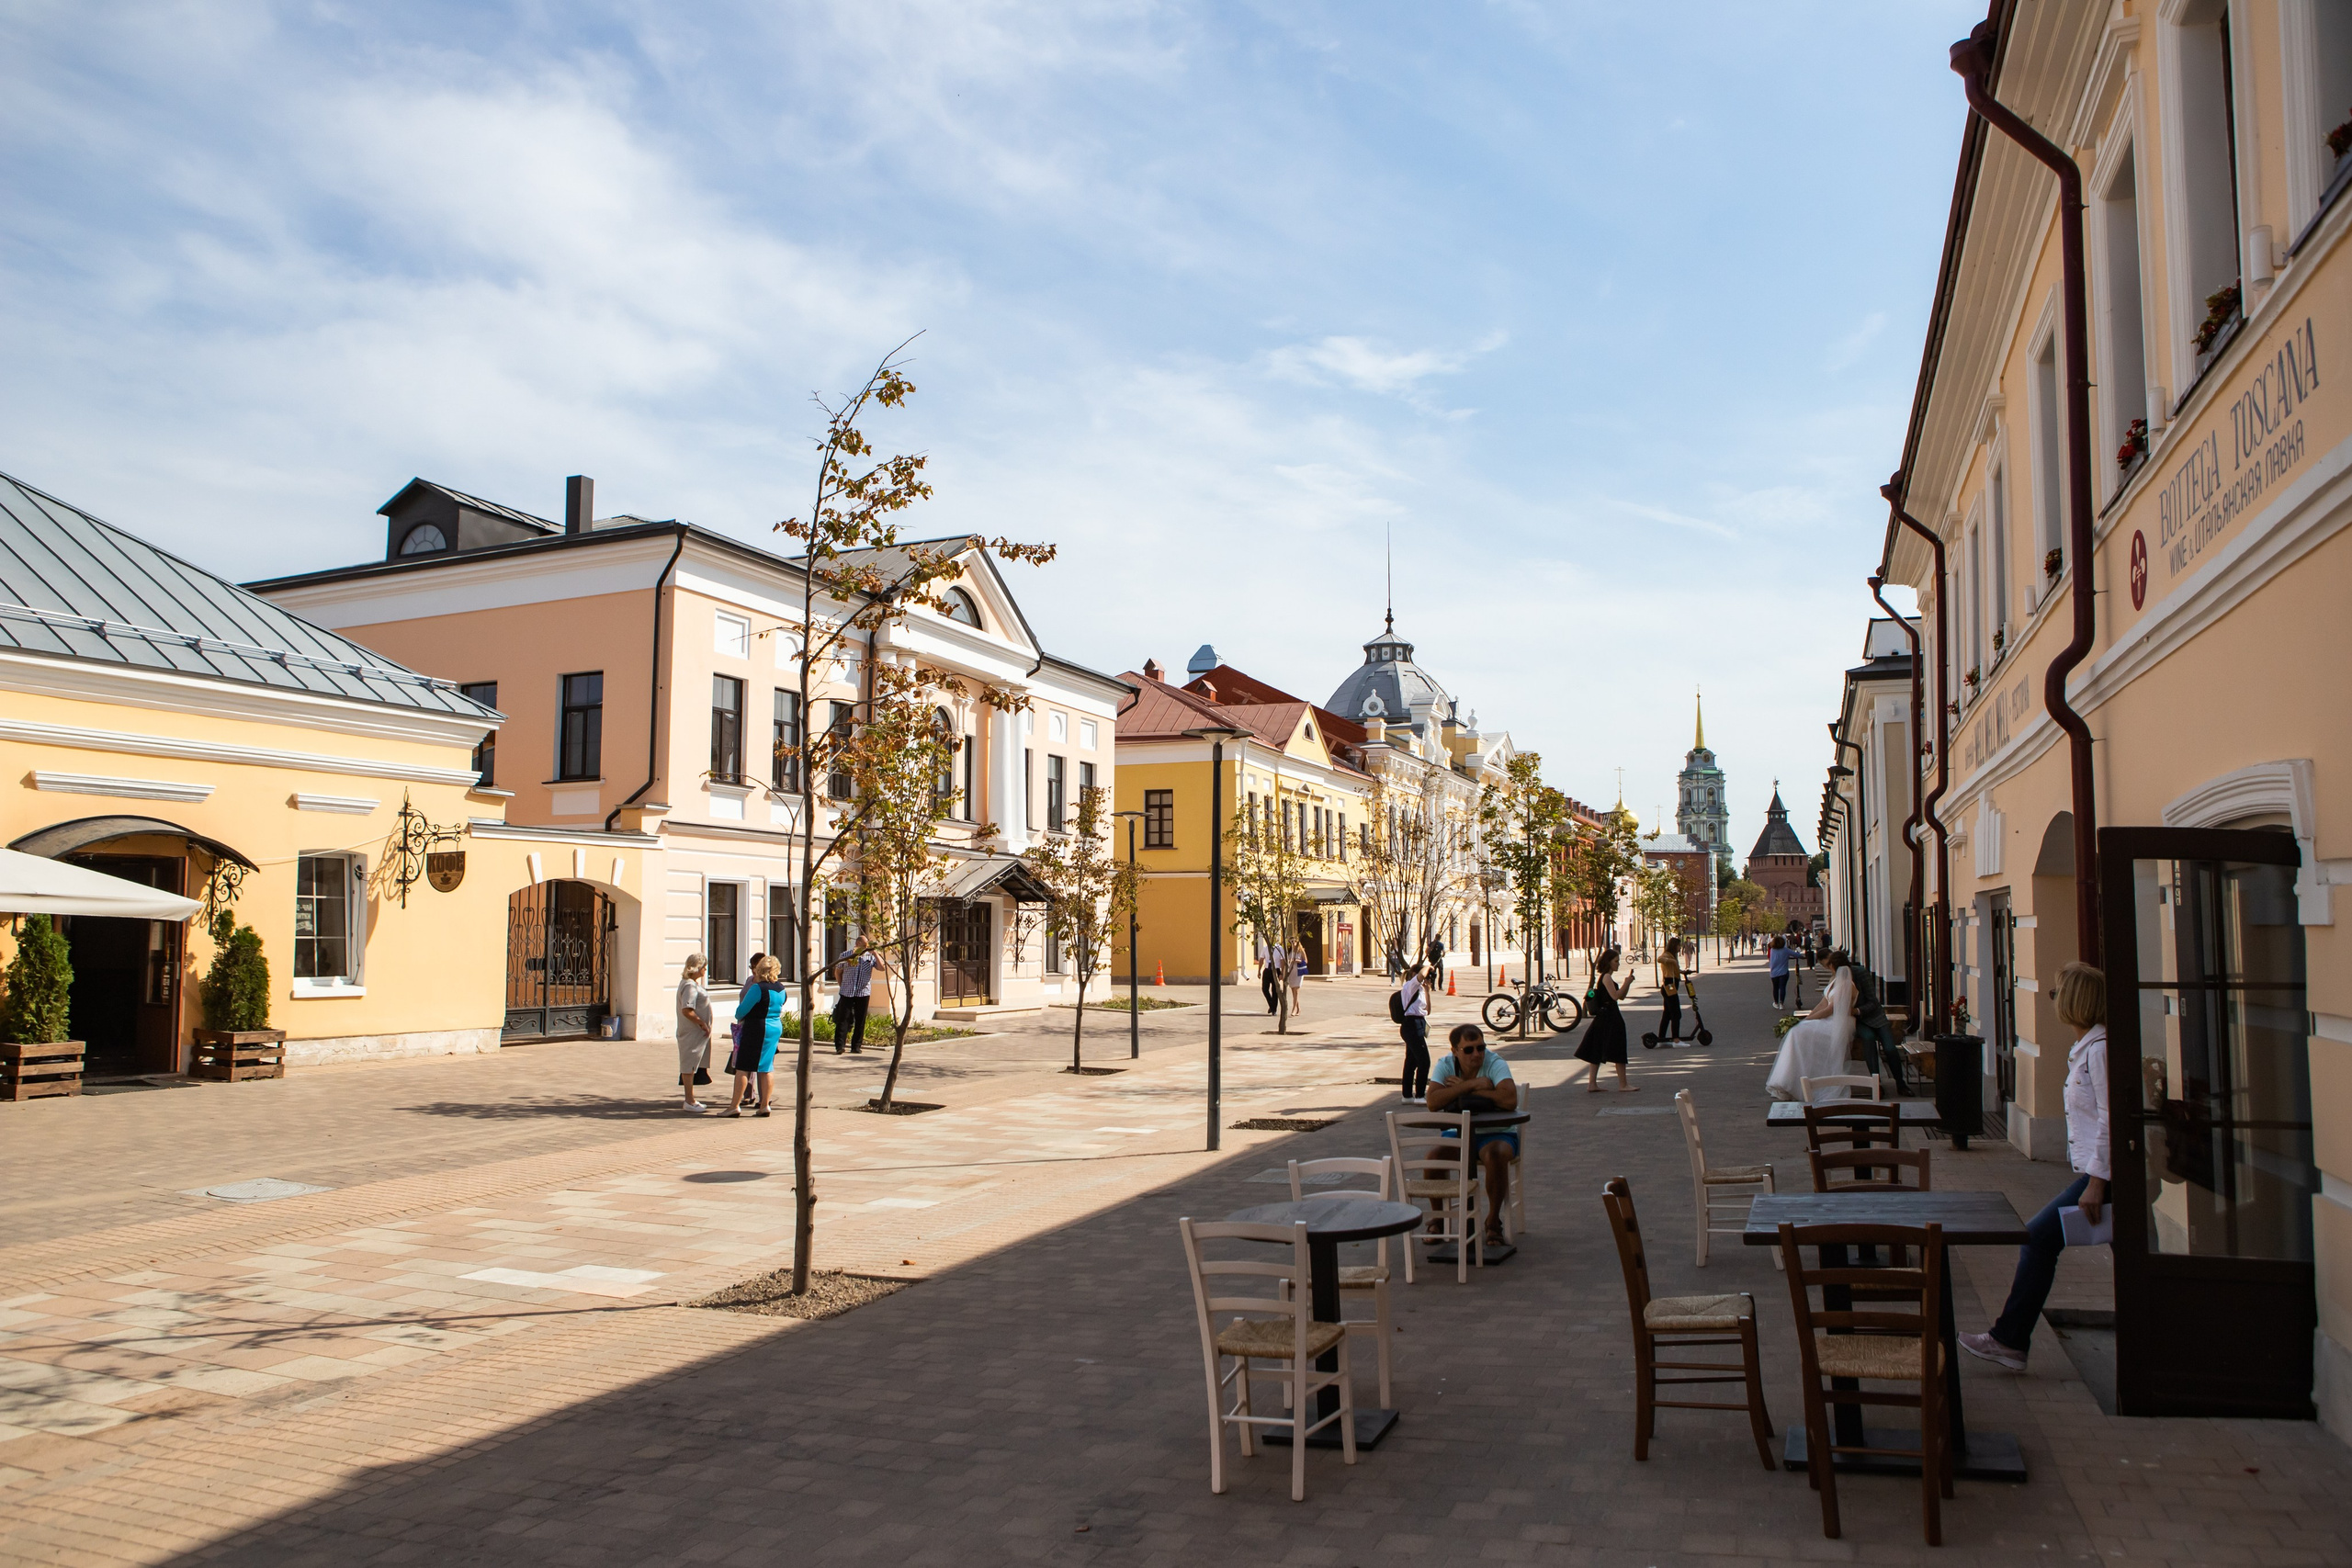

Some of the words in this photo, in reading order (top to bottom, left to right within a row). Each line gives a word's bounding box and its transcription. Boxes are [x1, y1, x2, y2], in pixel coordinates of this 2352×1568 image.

[2159, 430, 2221, 548] BOTTEGA
[2230, 317, 2319, 471] TOSCANA
[2169, 536, 2188, 579] WINE
[2194, 460, 2262, 554] ИТАЛЬЯНСКАЯ
[2266, 419, 2304, 489] ЛАВКА
[427, 852, 464, 874] КОФЕ
